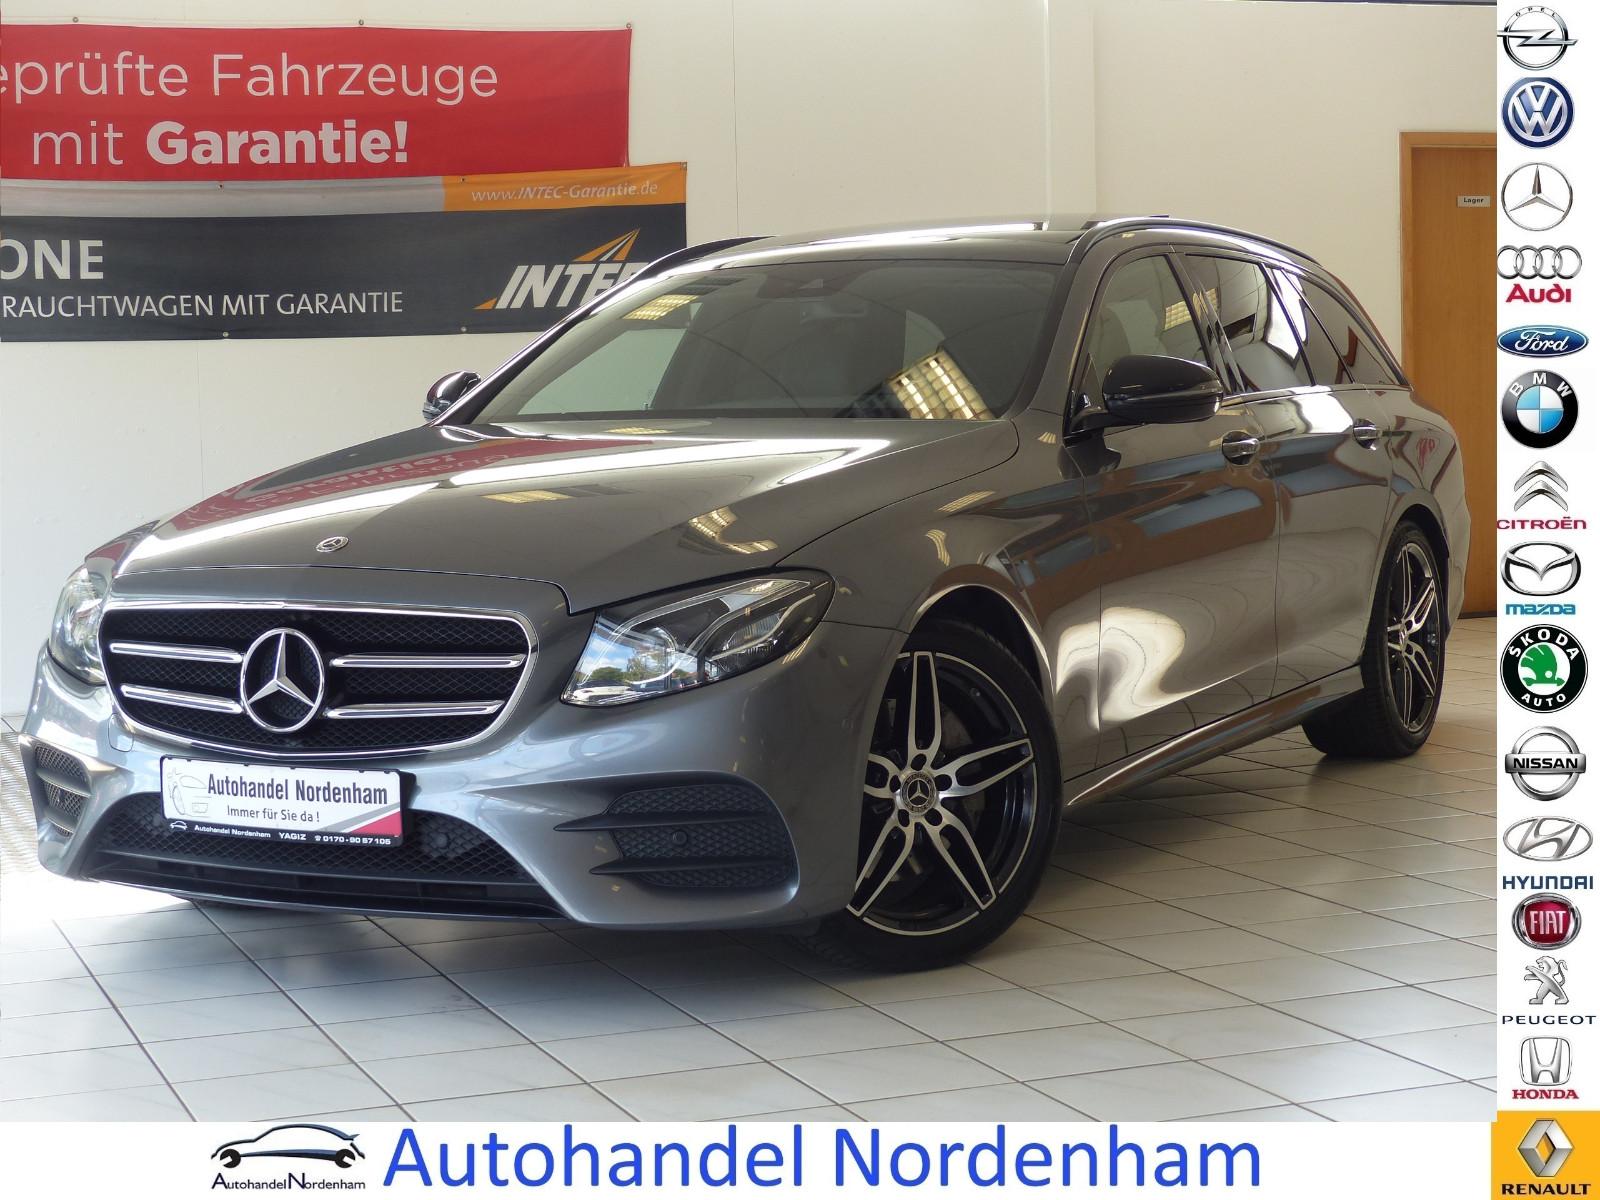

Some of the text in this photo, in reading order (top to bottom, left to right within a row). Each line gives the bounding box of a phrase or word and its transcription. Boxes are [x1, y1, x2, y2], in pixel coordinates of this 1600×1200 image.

[0, 50, 498, 105] prüfte Fahrzeuge
[32, 119, 408, 165] mit Garantie!
[471, 180, 659, 202] www.INTEC-Garantie.de
[0, 238, 104, 280] ONE
[2, 291, 404, 318] RAUCHTWAGEN MIT GARANTIE
[208, 773, 388, 805] Autohandel Nordenham
[227, 805, 260, 819] Immer
[262, 808, 278, 820] für
[281, 809, 298, 822] Sie
[194, 824, 230, 835] Autohandel
[231, 828, 271, 839] Nordenham
[278, 832, 307, 841] YAGIZ
